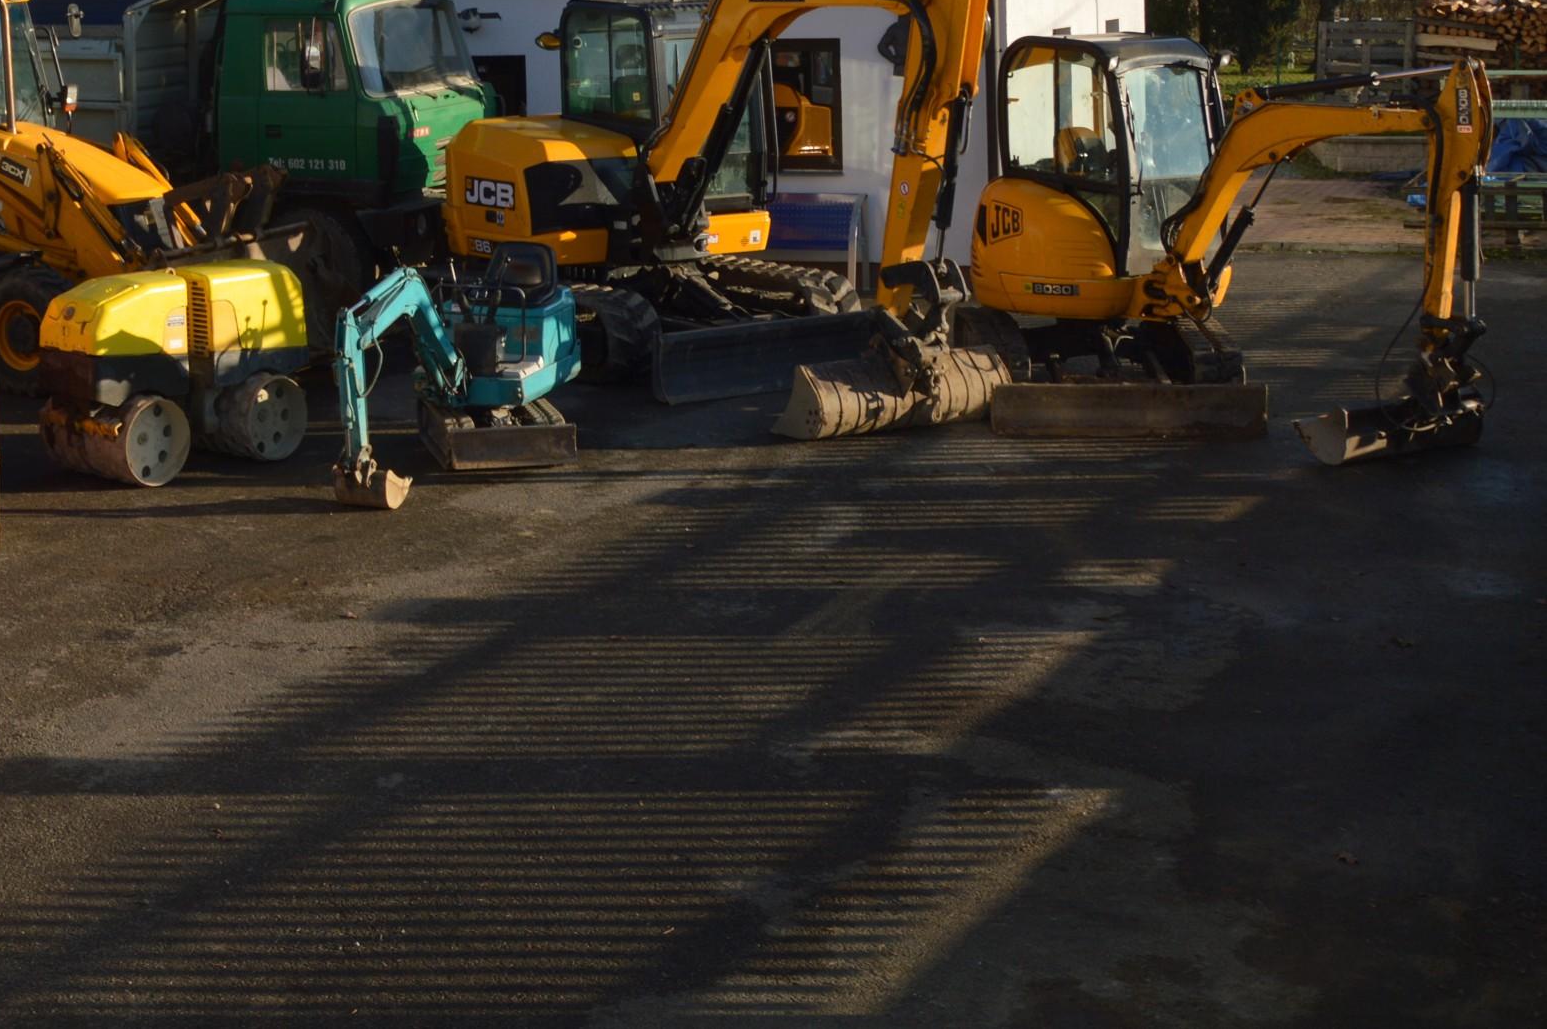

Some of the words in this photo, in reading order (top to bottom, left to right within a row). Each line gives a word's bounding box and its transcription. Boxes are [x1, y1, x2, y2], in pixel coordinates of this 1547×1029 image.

[1, 161, 23, 180] 3CX
[309, 158, 325, 170] 121
[329, 159, 347, 171] 310
[466, 179, 514, 208] JCB
[991, 204, 1020, 239] JCB
[475, 239, 493, 253] 86
[1034, 284, 1072, 295] 8030
